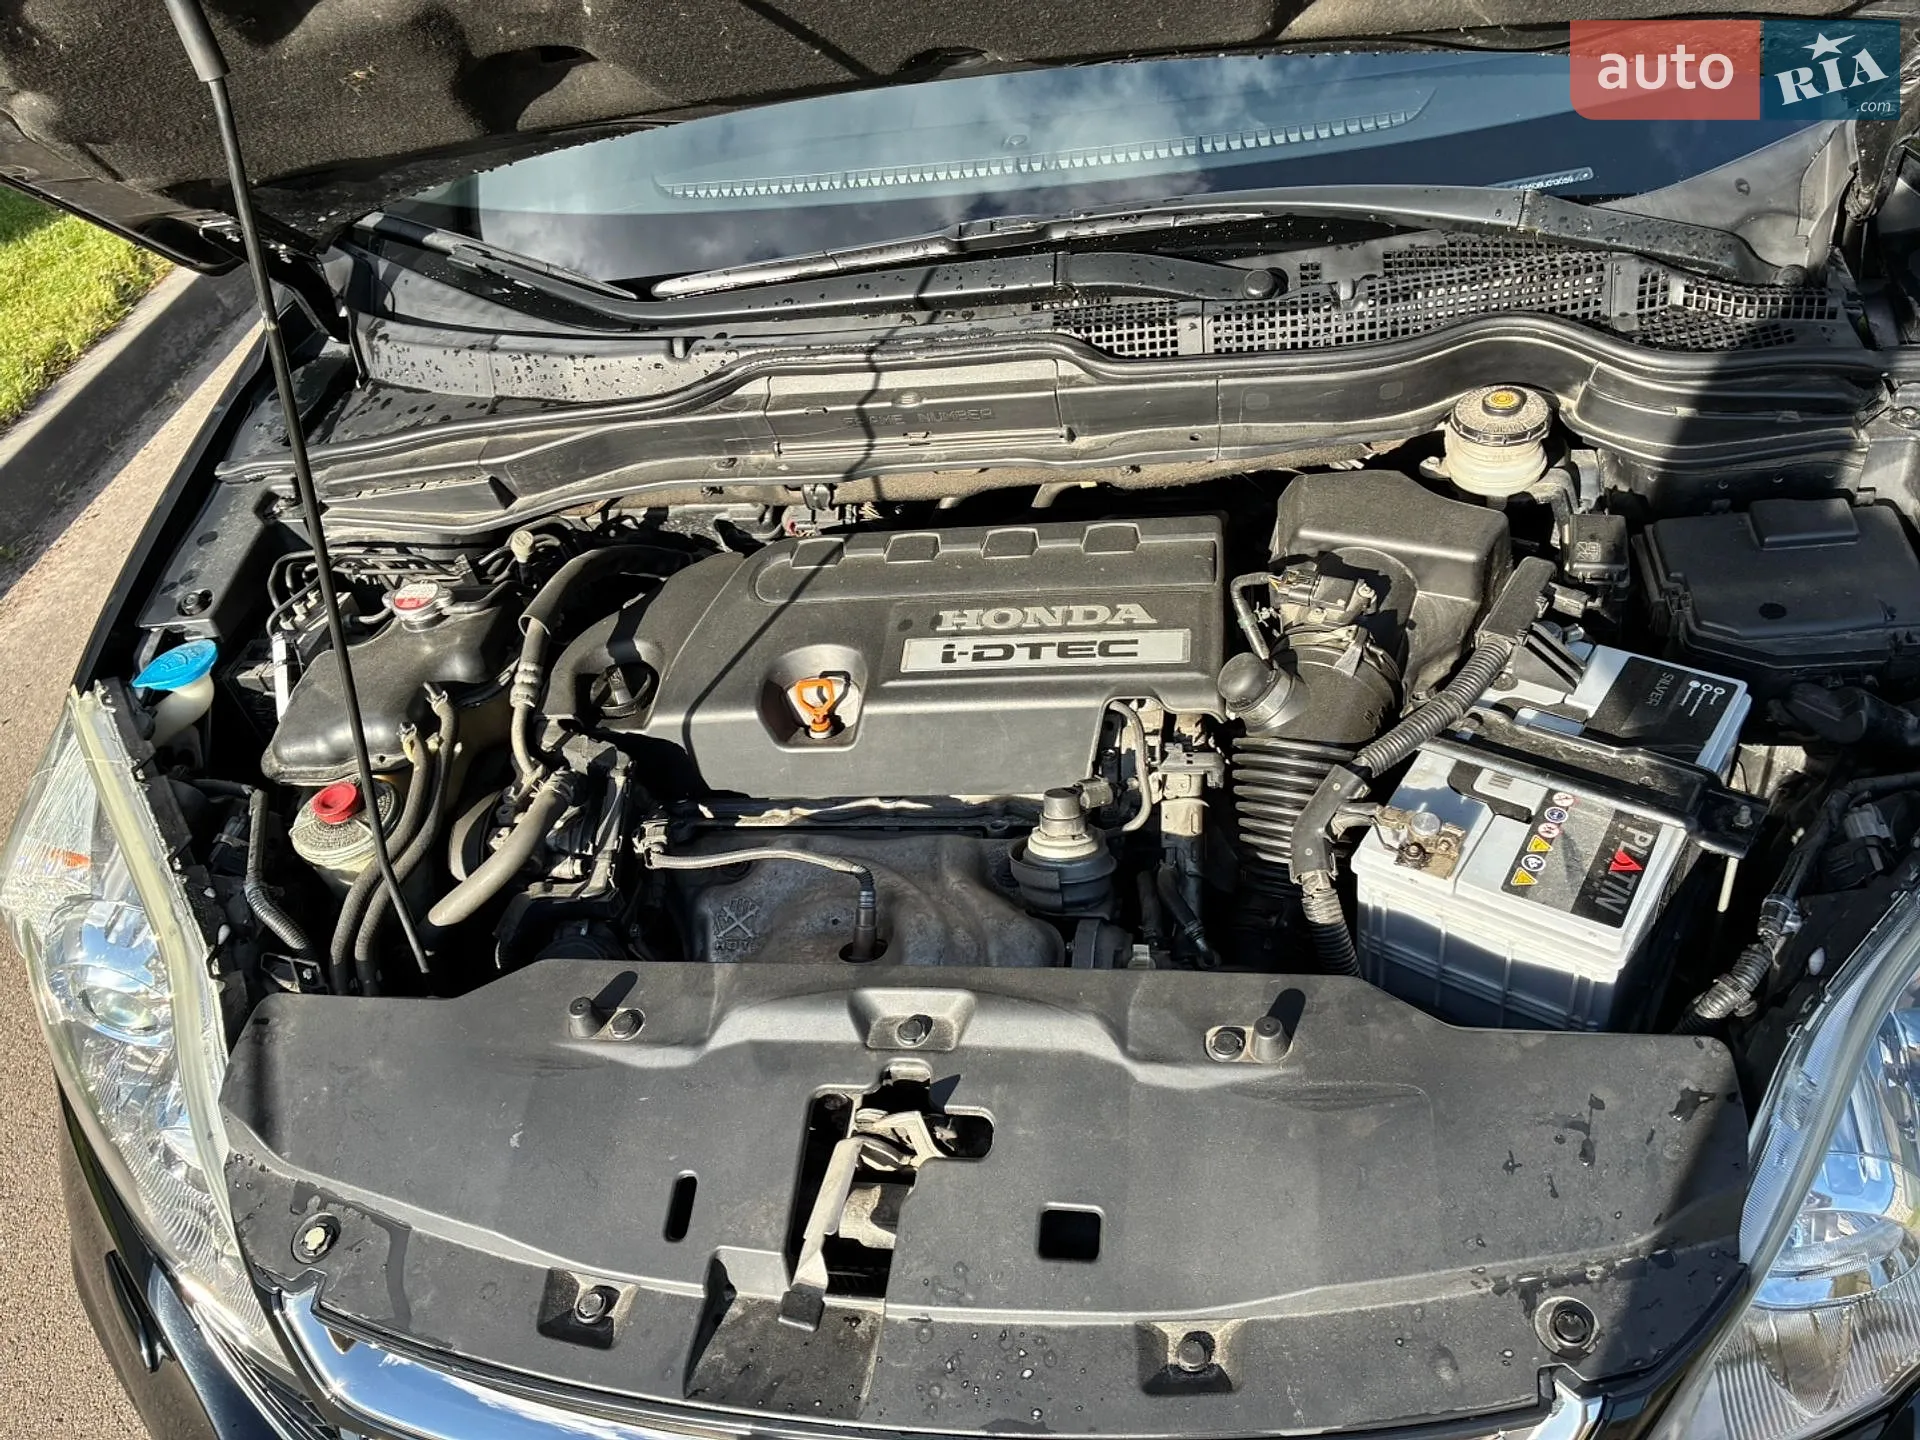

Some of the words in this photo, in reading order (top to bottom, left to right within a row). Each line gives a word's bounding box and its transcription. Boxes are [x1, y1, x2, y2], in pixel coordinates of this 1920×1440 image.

[936, 604, 1157, 631] HONDA
[941, 639, 1139, 664] i-DTEC
[1645, 672, 1675, 707] SILVER
